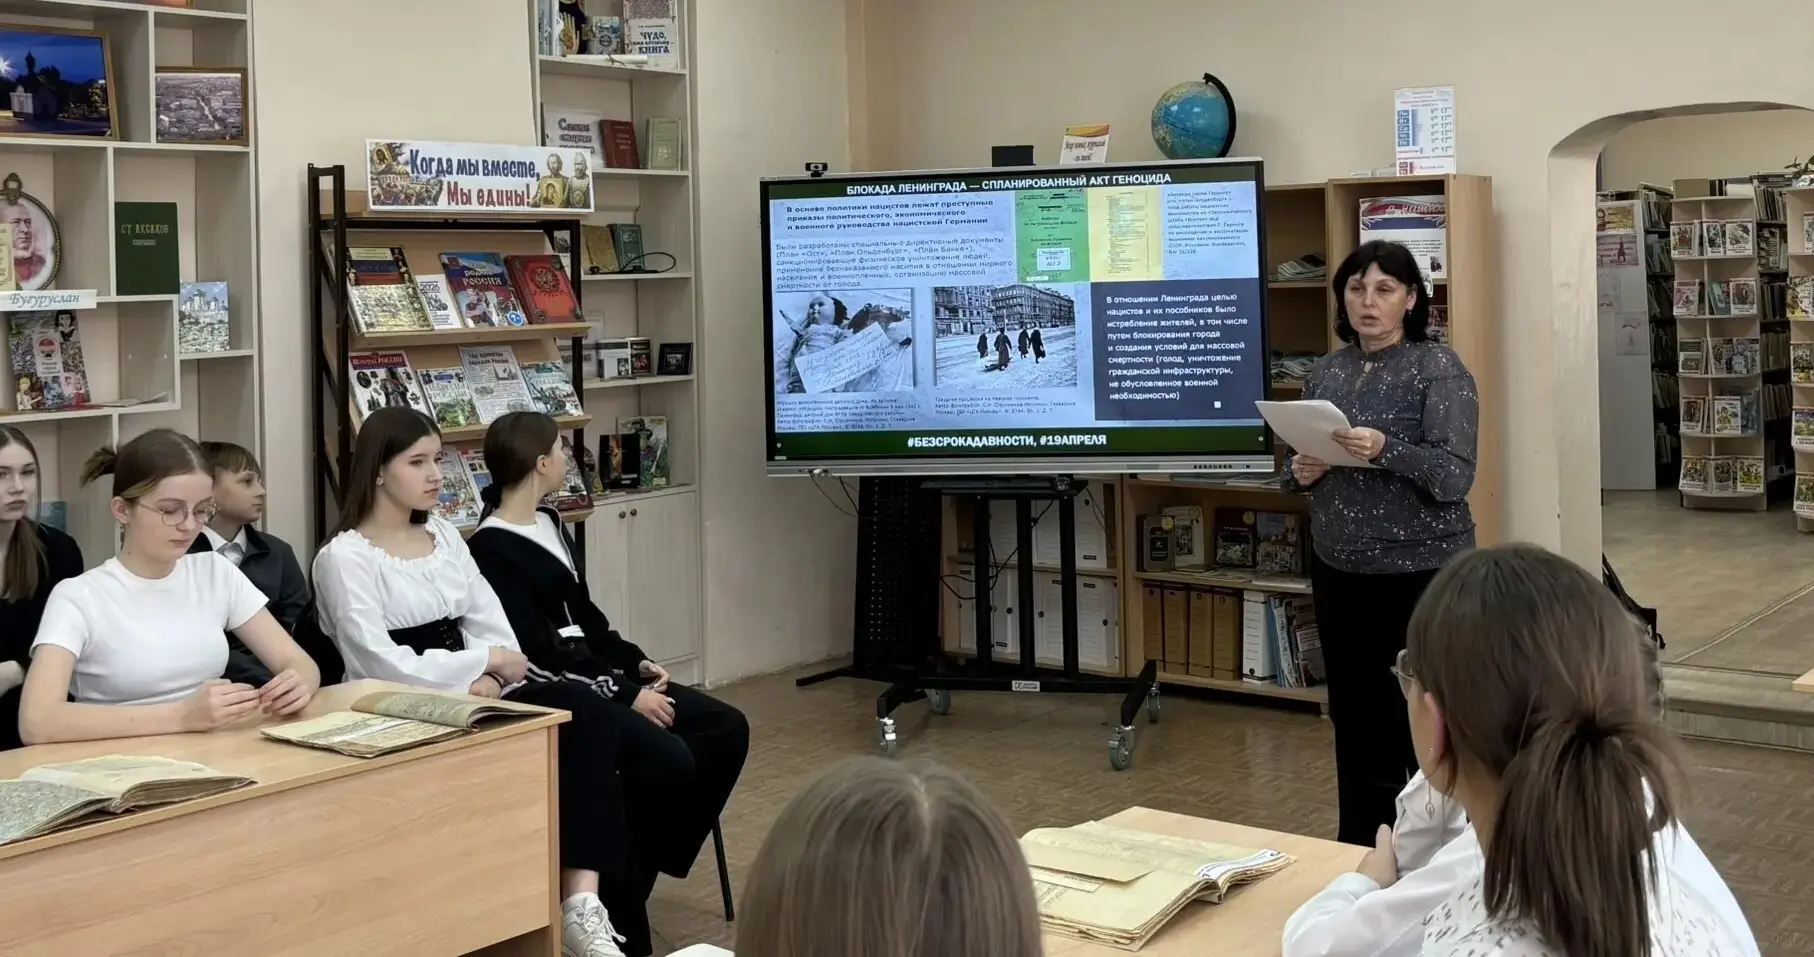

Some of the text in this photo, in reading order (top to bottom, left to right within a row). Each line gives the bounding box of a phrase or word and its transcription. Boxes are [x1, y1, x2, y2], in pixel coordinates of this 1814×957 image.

[639, 46, 670, 54] КНИГА
[410, 149, 540, 181] Когда мы вместе,
[847, 184, 896, 195] БЛОКАДА
[899, 182, 966, 193] ЛЕНИНГРАДА
[982, 176, 1086, 190] СПЛАНИРОВАННЫЙ
[1089, 176, 1110, 186] АКТ
[1112, 174, 1172, 186] ГЕНОЦИДА
[447, 181, 531, 207] Мы едины!
[787, 215, 824, 223] приказы
[837, 222, 890, 230] руководства
[893, 219, 942, 227] нацистской
[945, 218, 989, 226] Германии
[9, 293, 80, 308] Бугуруслан
[1106, 295, 1112, 303] В
[1160, 294, 1209, 304] Ленинграда
[1107, 308, 1144, 316] нацистов
[1165, 306, 1213, 314] пособников
[1107, 319, 1158, 329] истребление
[1160, 318, 1197, 327] жителей,
[1107, 331, 1221, 341] путем блокирования города
[1154, 343, 1188, 353] условий
[1207, 342, 1245, 350] массовой
[1108, 355, 1242, 365] смертности (голод, уничтожение
[1109, 367, 1234, 377] гражданской инфраструктуры,
[1121, 379, 1182, 389] обусловленное
[1184, 379, 1219, 387] военной
[1110, 391, 1180, 401] необходимостью)
[908, 435, 1107, 448] #БЕЗСРОКАДАВНОСТИ, #19АПРЕЛЯ
